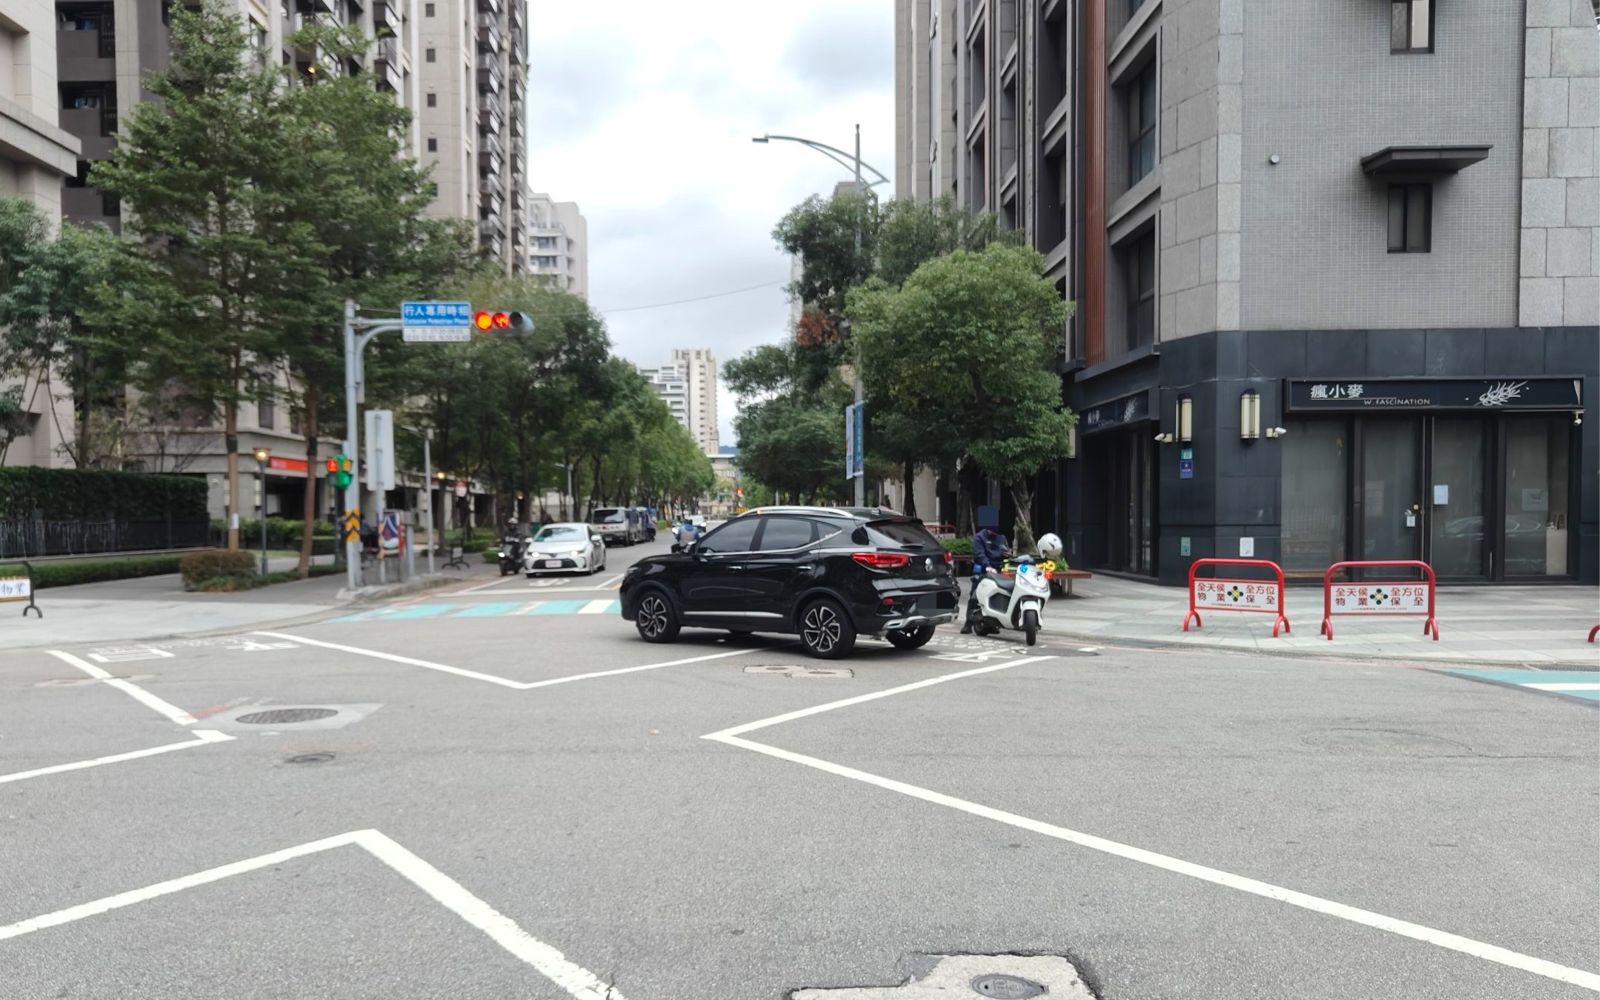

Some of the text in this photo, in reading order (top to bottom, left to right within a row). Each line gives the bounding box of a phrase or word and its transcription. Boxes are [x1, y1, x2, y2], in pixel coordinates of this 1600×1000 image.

[1310, 383, 1364, 399] 瘋小麥
[1376, 398, 1431, 407] FASCINATION
[1246, 584, 1275, 595] 全方位
[1390, 586, 1424, 597] 全方位
